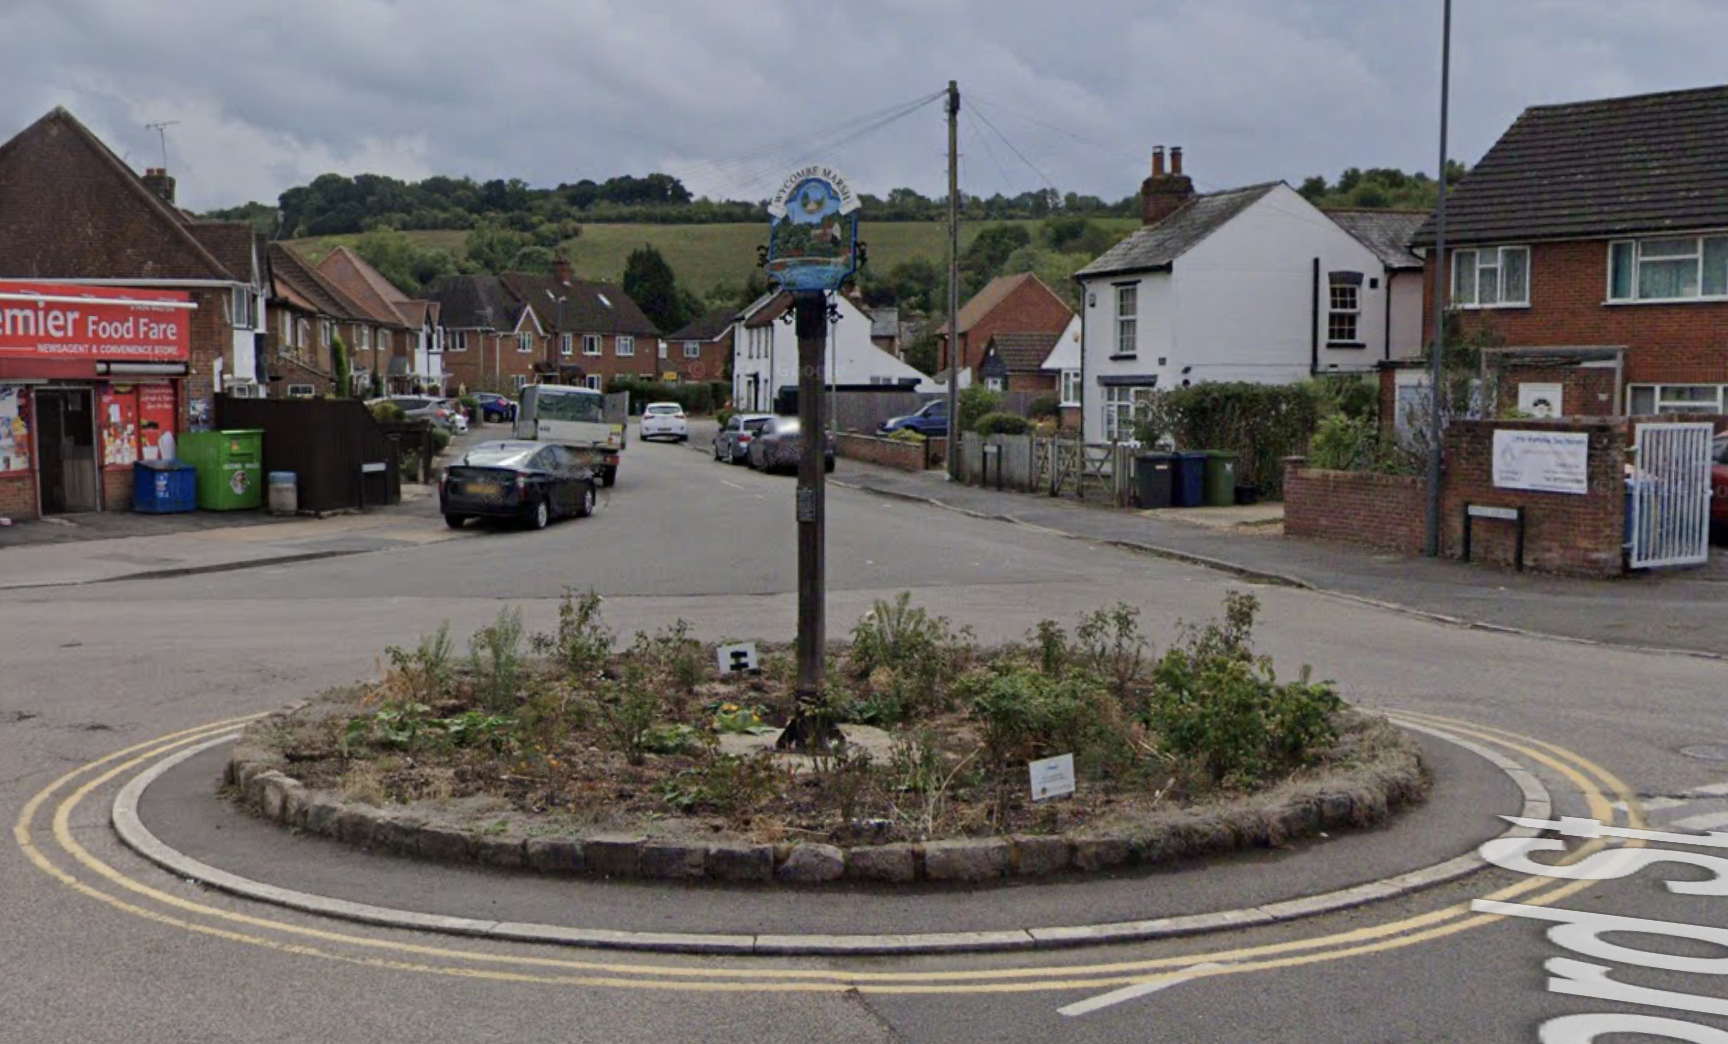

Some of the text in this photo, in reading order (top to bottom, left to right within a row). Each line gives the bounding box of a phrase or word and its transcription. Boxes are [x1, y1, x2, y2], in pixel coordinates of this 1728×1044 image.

[774, 166, 852, 203] WYCOMBE MARSH
[0, 300, 178, 340] mier Food Fare
[37, 343, 179, 356] NEWSAGENT & CONVENIENCE STORE
